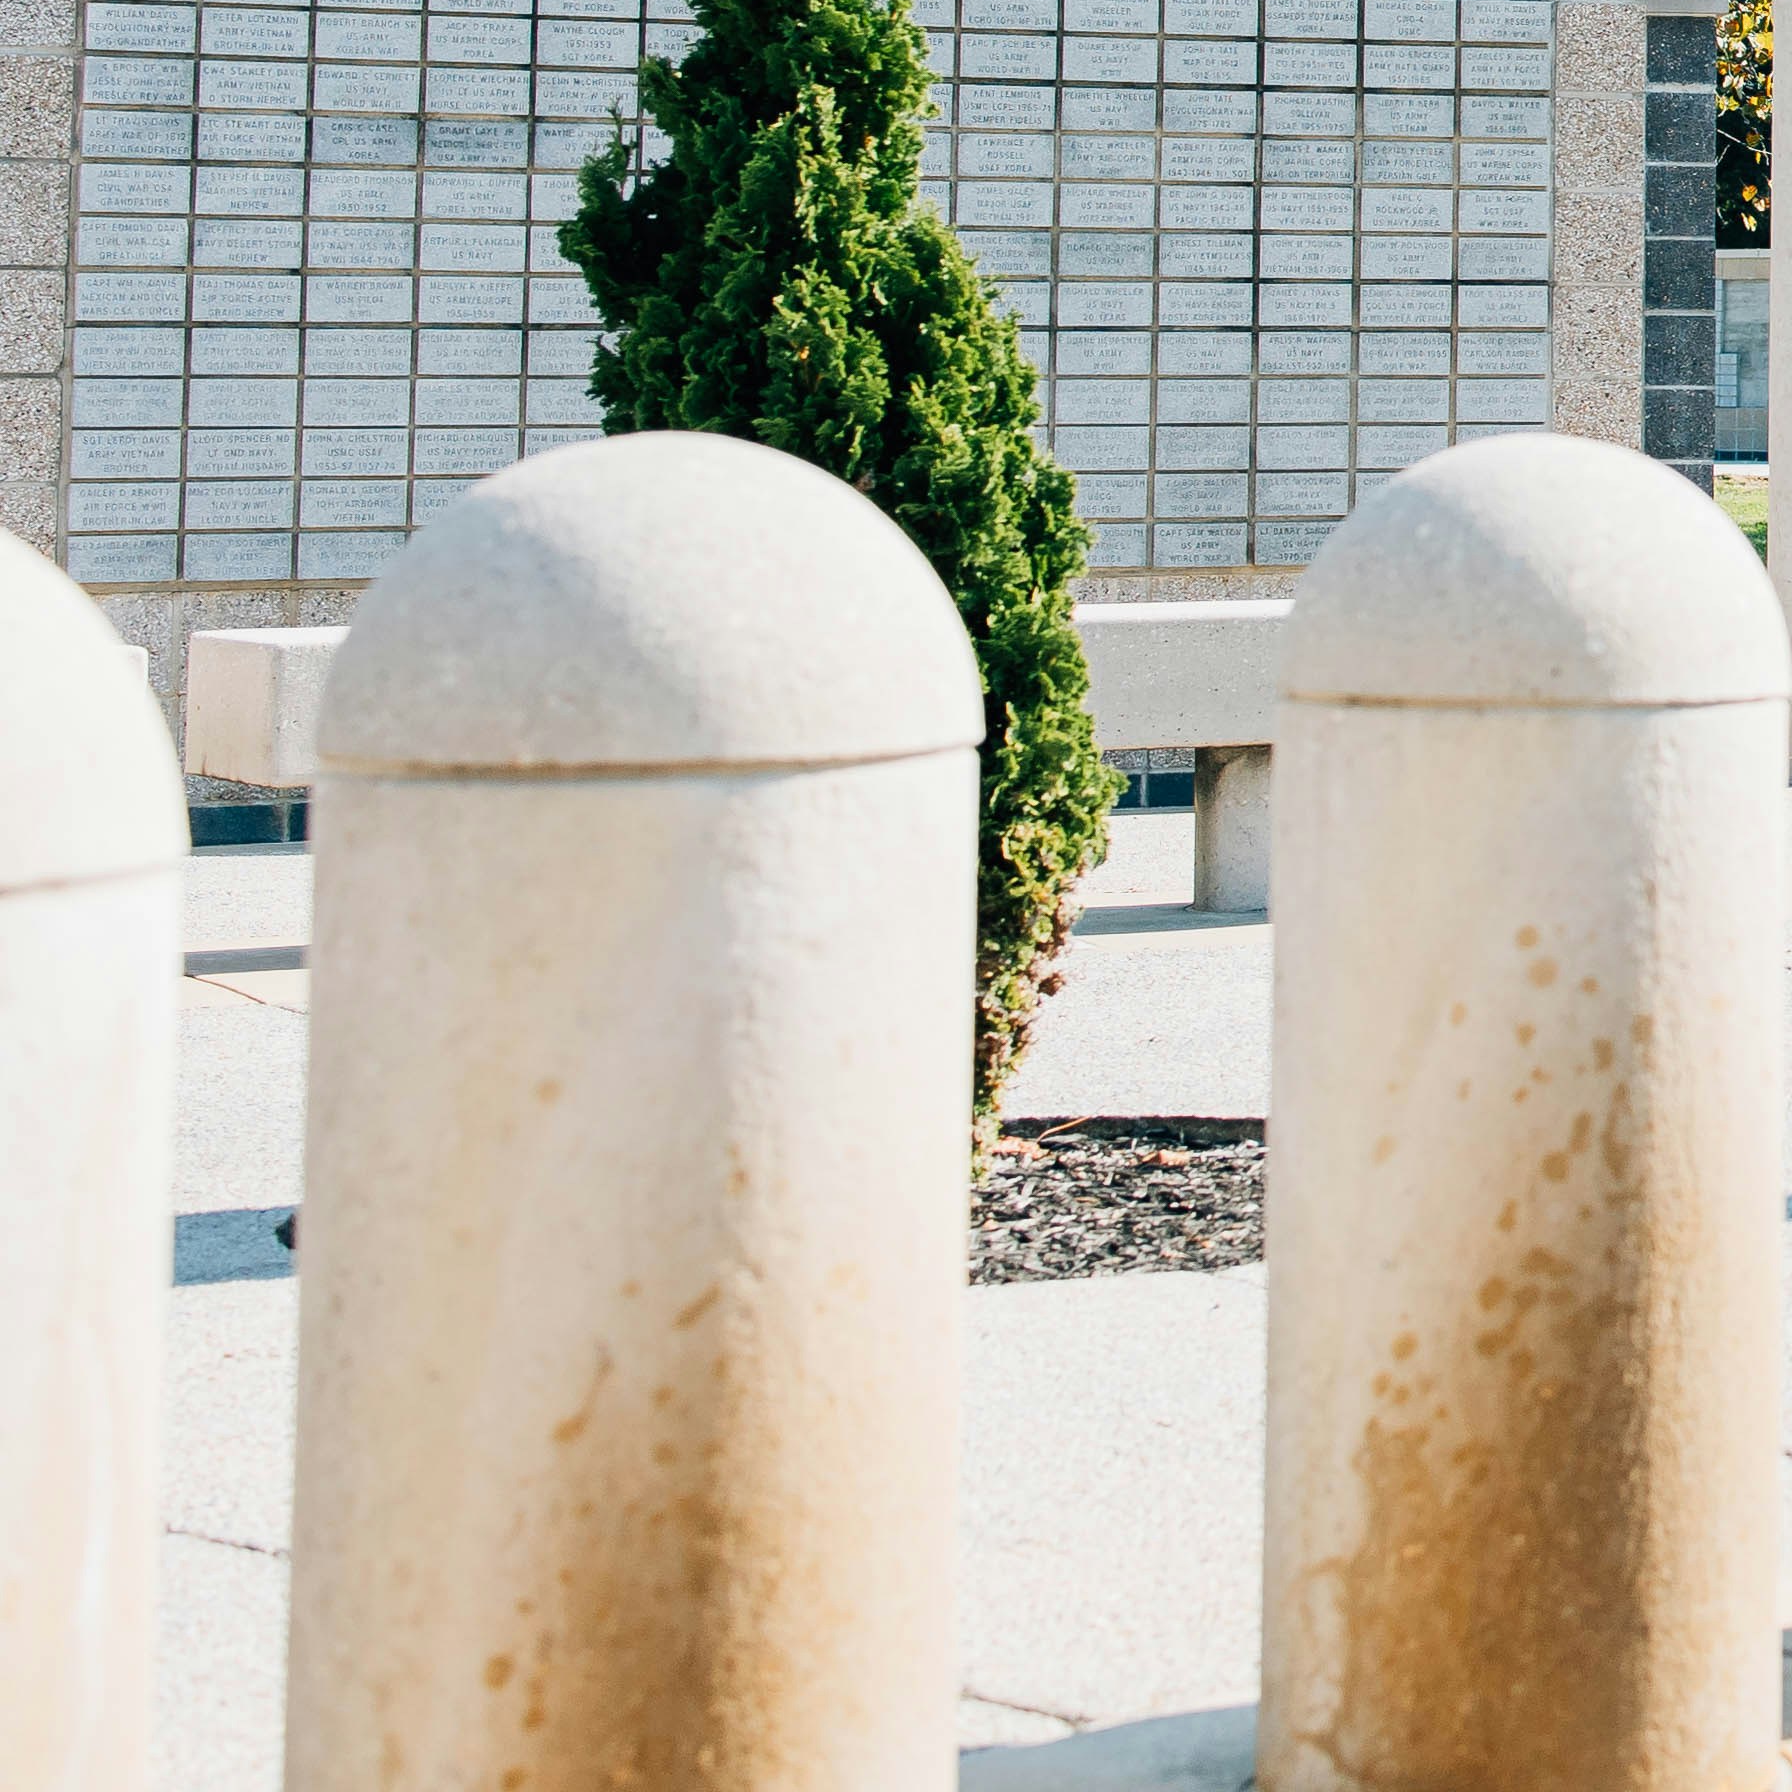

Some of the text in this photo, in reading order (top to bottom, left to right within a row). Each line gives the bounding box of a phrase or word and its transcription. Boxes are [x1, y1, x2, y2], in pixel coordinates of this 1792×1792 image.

[971, 115, 1042, 125] SEMPER FIDELIS
[348, 151, 381, 160] KOREA
